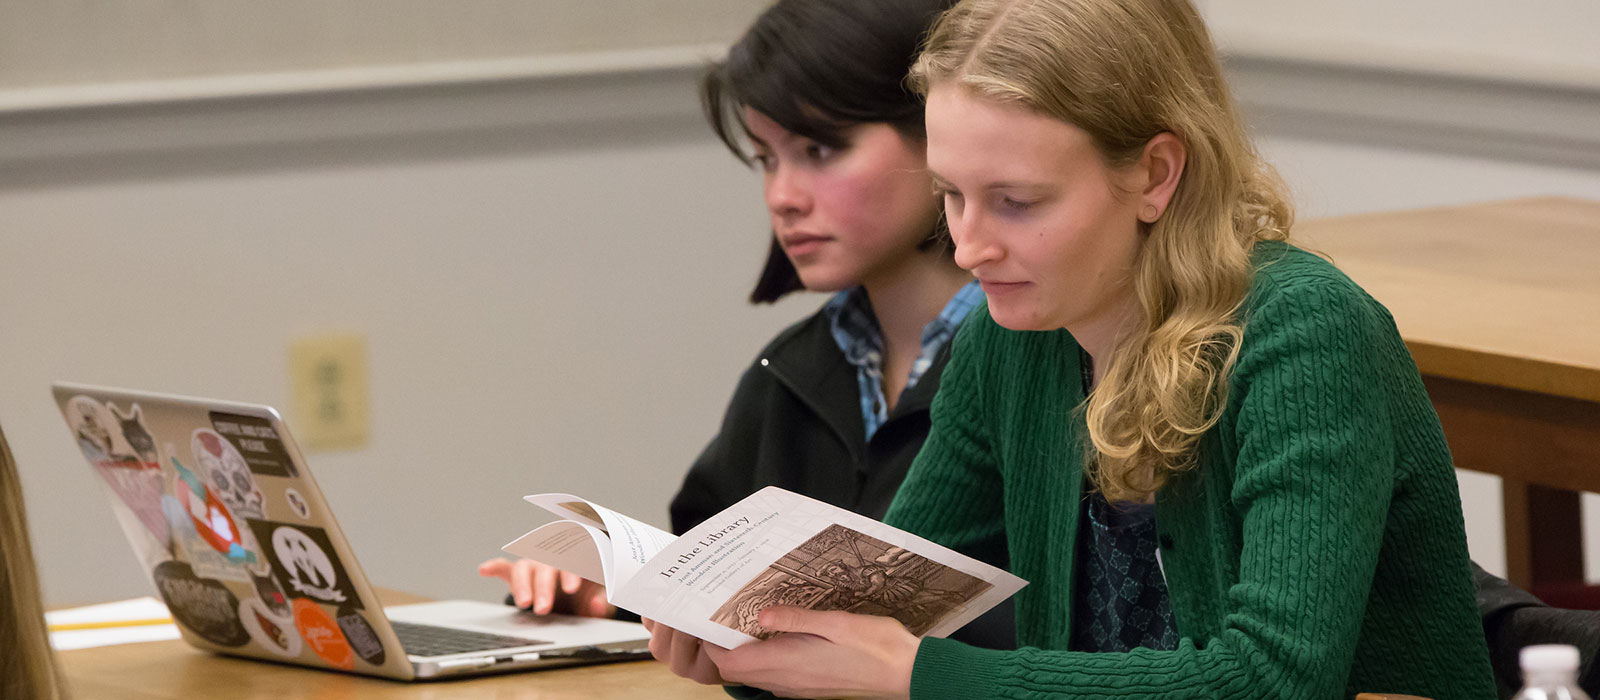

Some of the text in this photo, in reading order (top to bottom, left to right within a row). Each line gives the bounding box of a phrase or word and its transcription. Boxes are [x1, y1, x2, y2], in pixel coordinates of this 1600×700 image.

[660, 566, 679, 578] In
[678, 546, 702, 564] the
[699, 516, 750, 547] Library
[686, 565, 712, 587] Woodcut
[711, 542, 745, 566] Illustration
[691, 555, 714, 572] Amman
[714, 545, 725, 554] and
